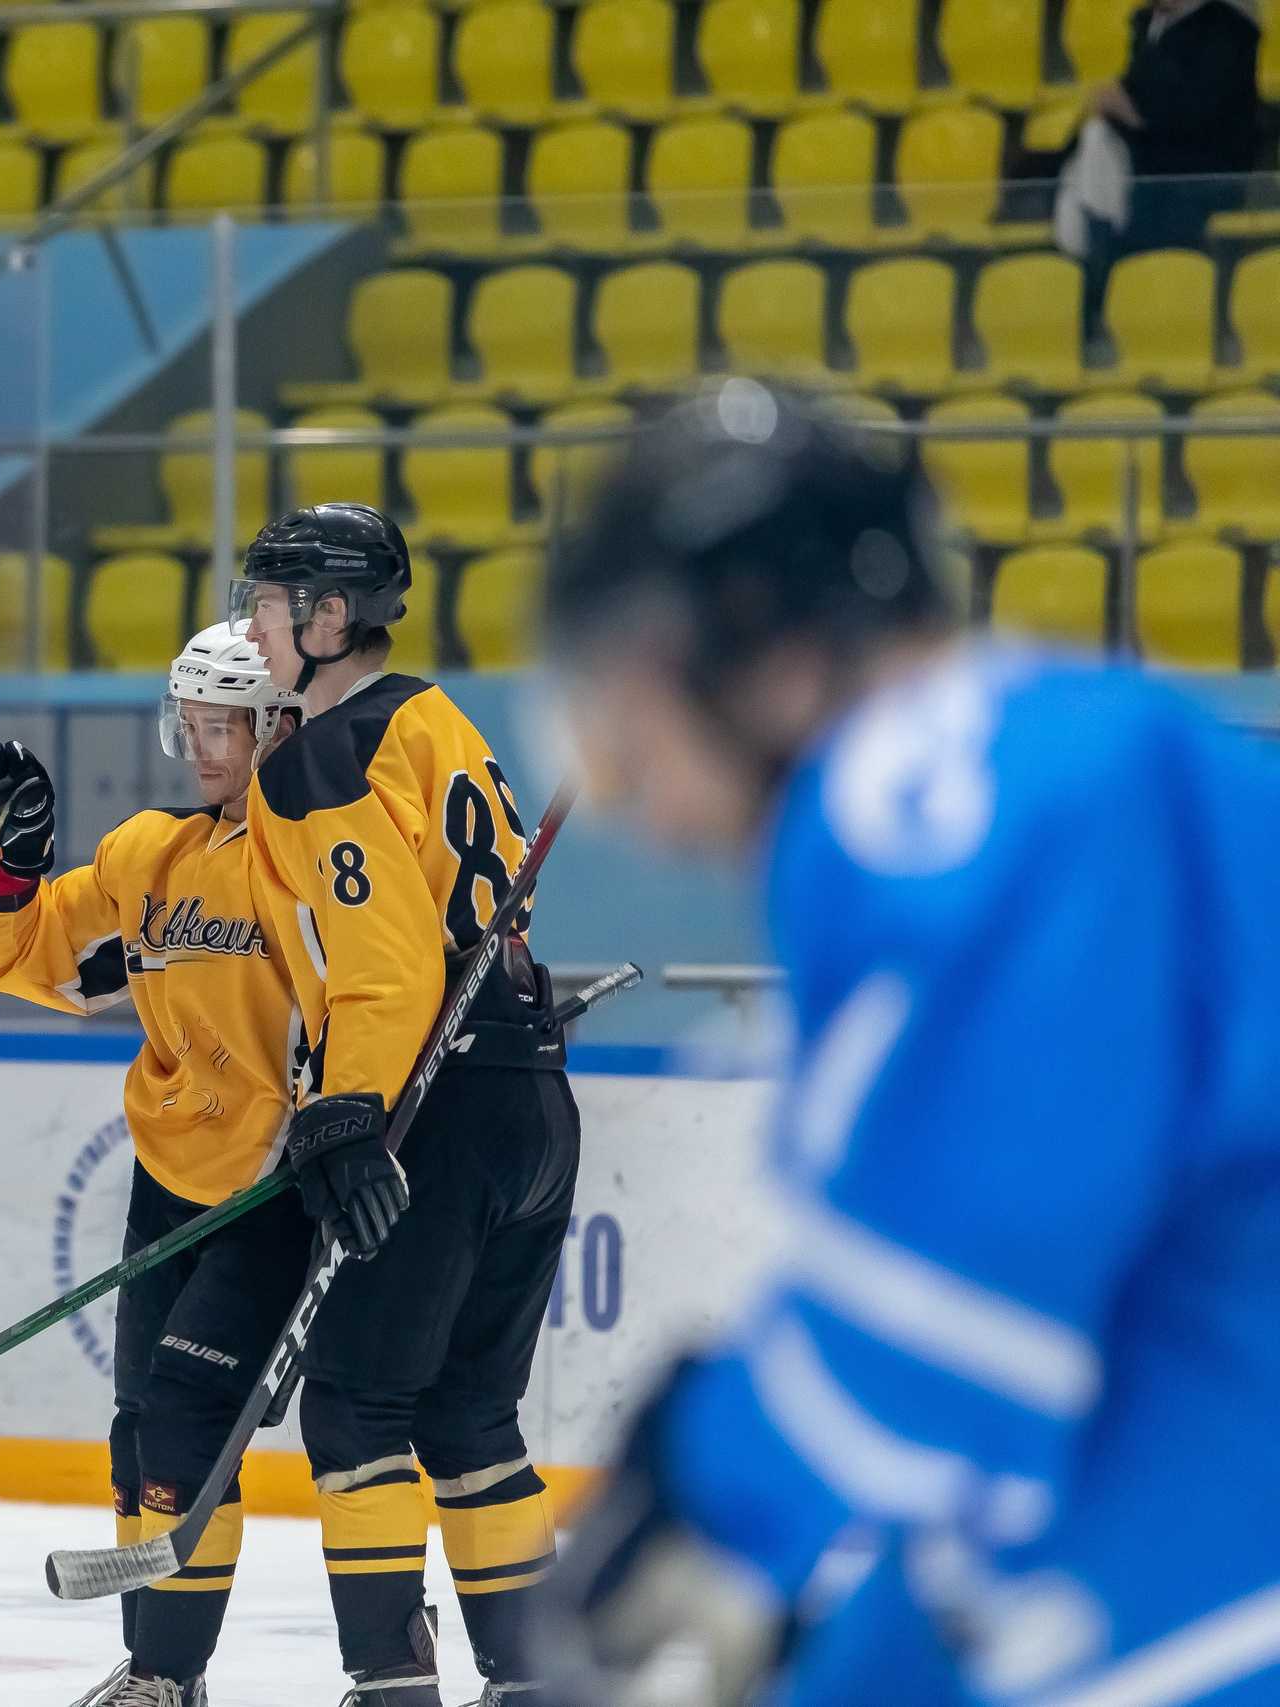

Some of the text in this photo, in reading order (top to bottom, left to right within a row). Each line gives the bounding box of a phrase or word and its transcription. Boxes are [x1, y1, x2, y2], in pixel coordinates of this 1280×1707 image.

[177, 665, 208, 676] CCM
[317, 840, 372, 907] 8
[415, 933, 499, 1108] JETSPEED
[262, 1238, 345, 1397] CCM
[160, 1334, 239, 1370] BAUER
[144, 1499, 176, 1511] EASTON
